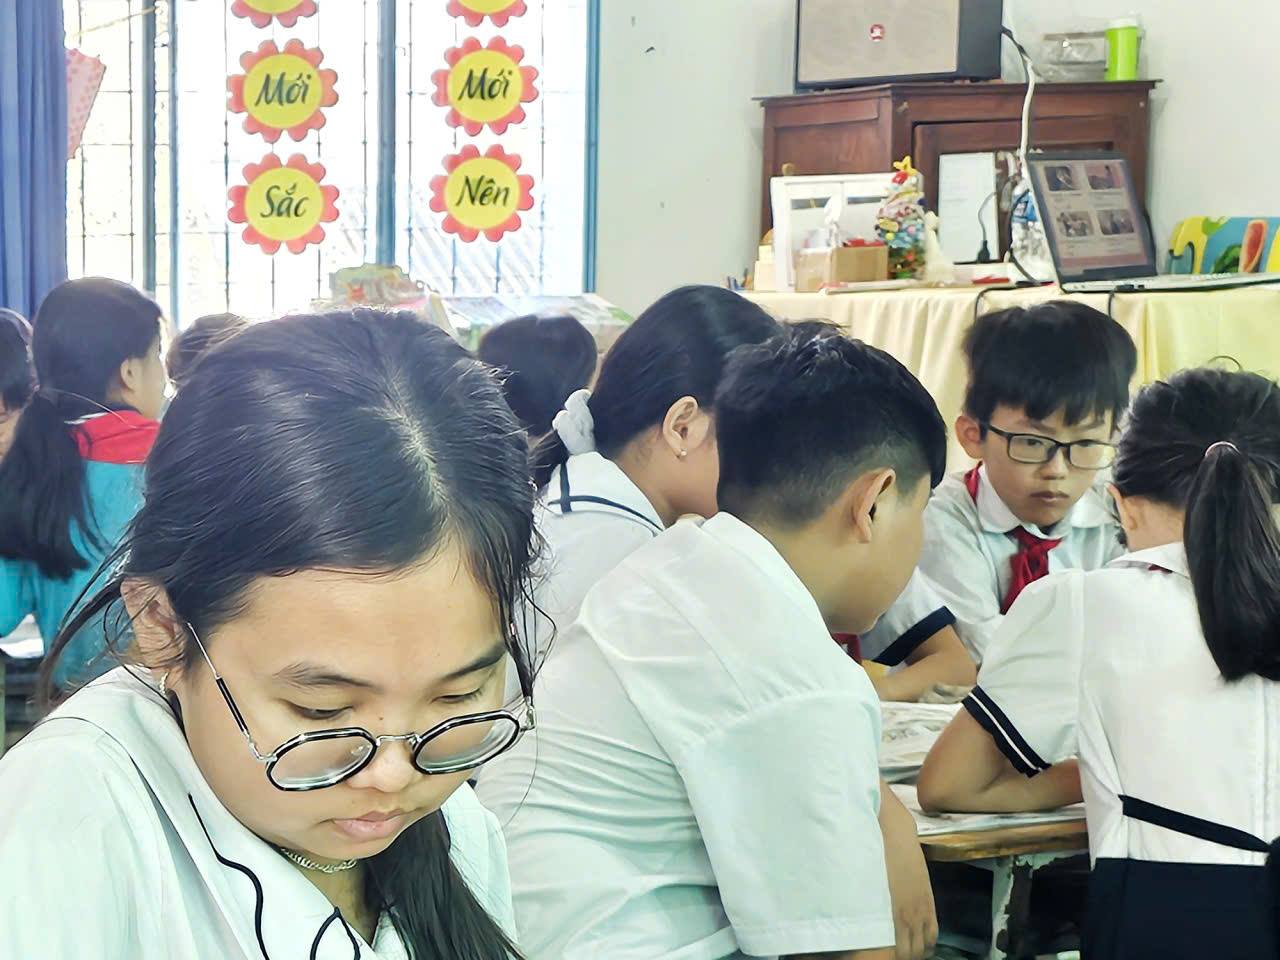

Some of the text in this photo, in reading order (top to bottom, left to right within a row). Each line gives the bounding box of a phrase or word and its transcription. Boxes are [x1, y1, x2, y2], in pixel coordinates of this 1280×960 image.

[255, 72, 312, 107] Mới
[458, 67, 513, 101] Mới
[259, 183, 309, 218] Sắc
[455, 175, 511, 207] Nên
